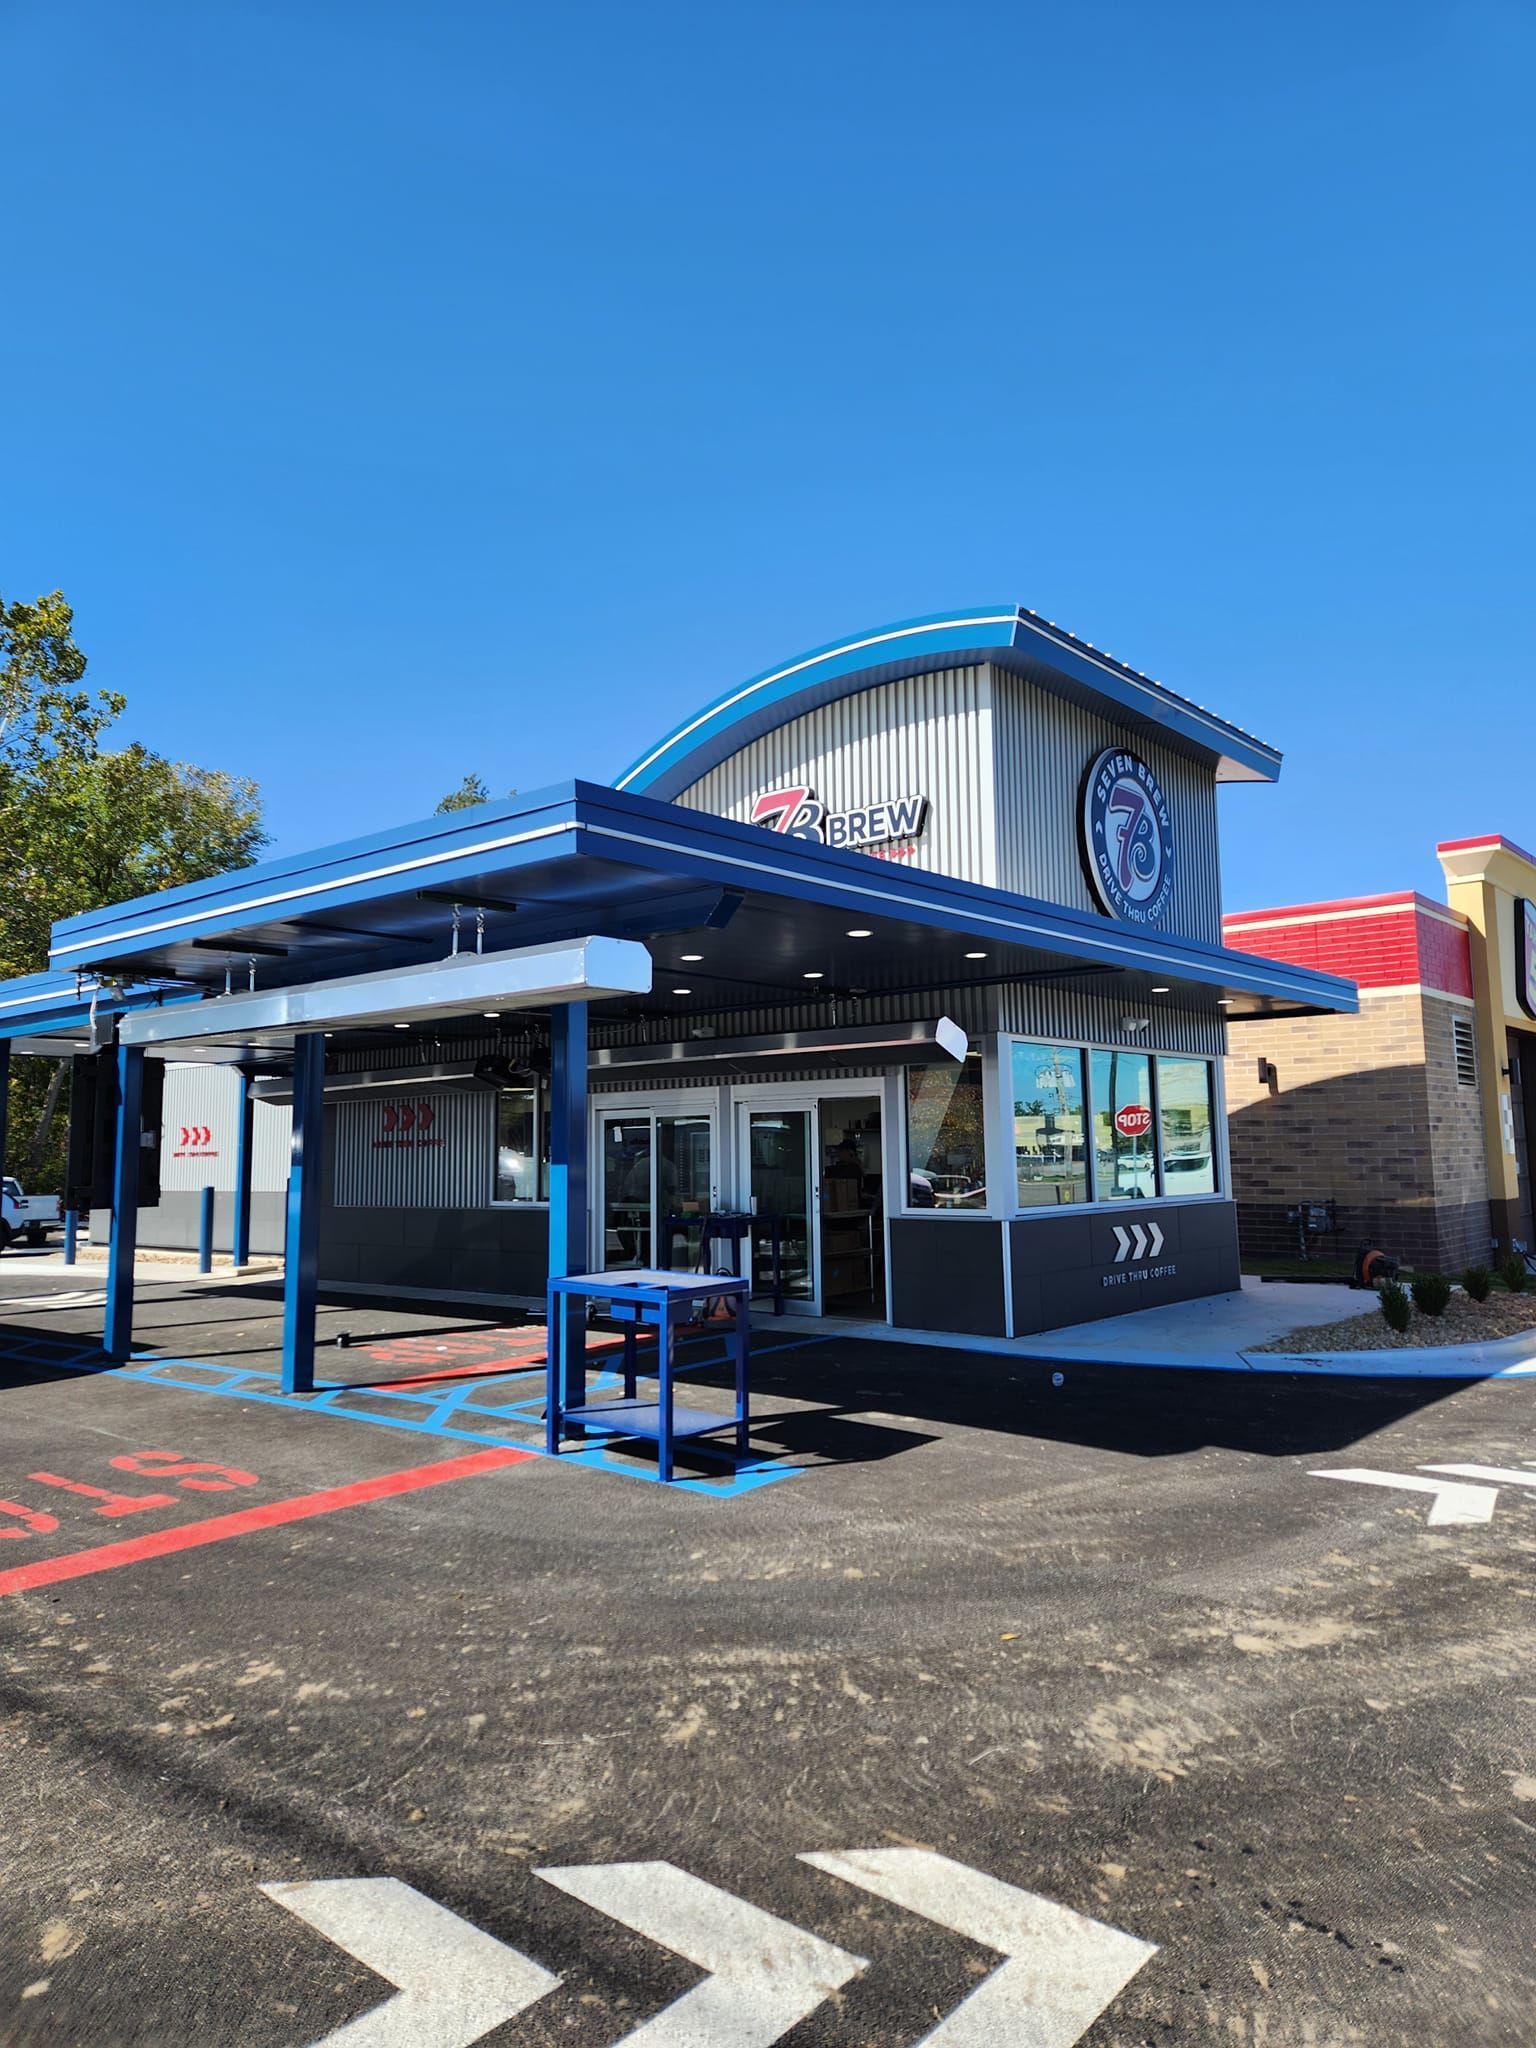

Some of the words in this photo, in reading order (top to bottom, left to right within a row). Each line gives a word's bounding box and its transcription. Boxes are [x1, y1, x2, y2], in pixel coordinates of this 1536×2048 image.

[827, 796, 921, 848] BREW
[1097, 755, 1133, 803] SEVEN
[1137, 762, 1170, 827] BREW
[1098, 851, 1122, 906] DRIVE
[1122, 900, 1146, 924] THRU
[1147, 873, 1172, 921] COFFEE
[1102, 1272, 1127, 1287] DRIVE
[1128, 1269, 1148, 1281] THRU
[1149, 1264, 1177, 1279] COFFEE
